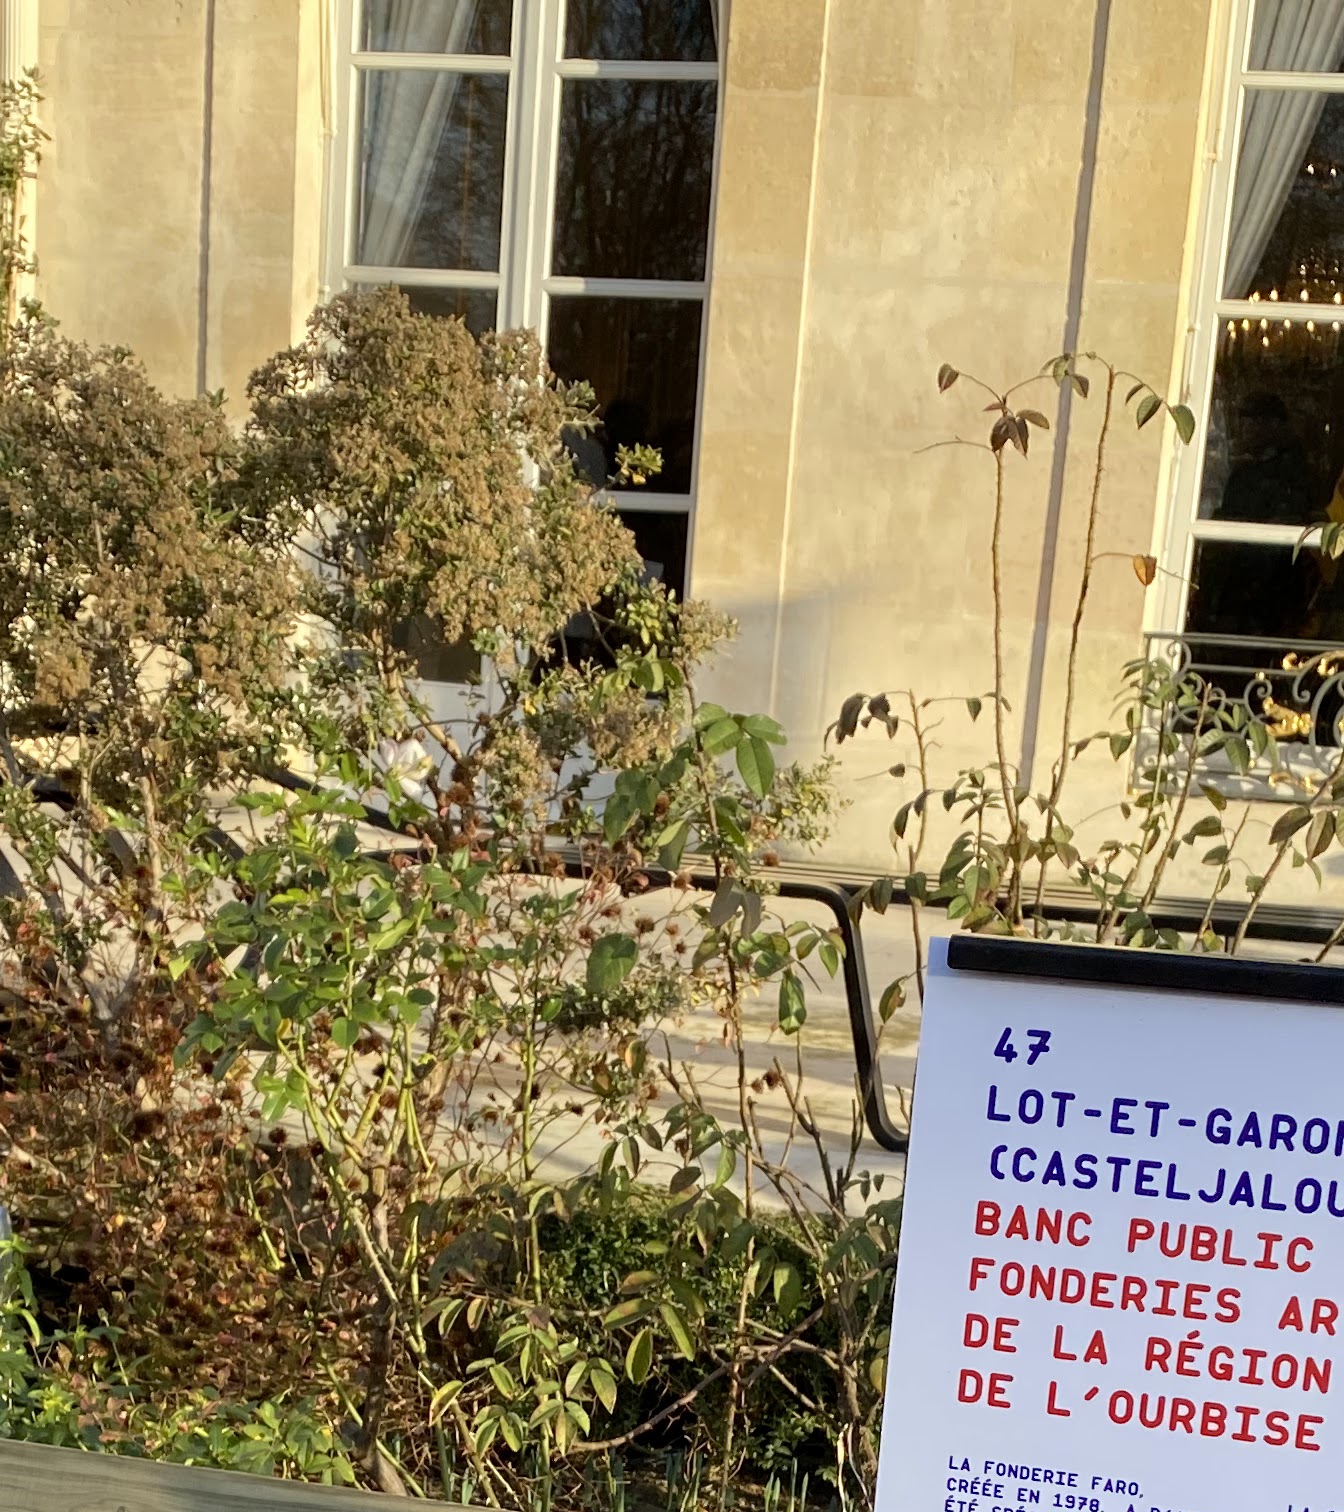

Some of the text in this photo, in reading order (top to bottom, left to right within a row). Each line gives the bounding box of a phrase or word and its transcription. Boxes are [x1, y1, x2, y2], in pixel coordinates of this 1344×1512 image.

[992, 1025, 1052, 1066] 47
[973, 1198, 1314, 1274] BANC PUBLIC
[967, 1255, 1242, 1324] FONDERIES
[961, 1311, 1333, 1395] DE LA RÉGION
[956, 1367, 1325, 1452] DE L'OURBISE
[945, 1475, 1005, 1499] CRÉÉE
[1015, 1486, 1041, 1505] EN
[947, 1454, 1144, 1499] LA FONDERIE FARO,
